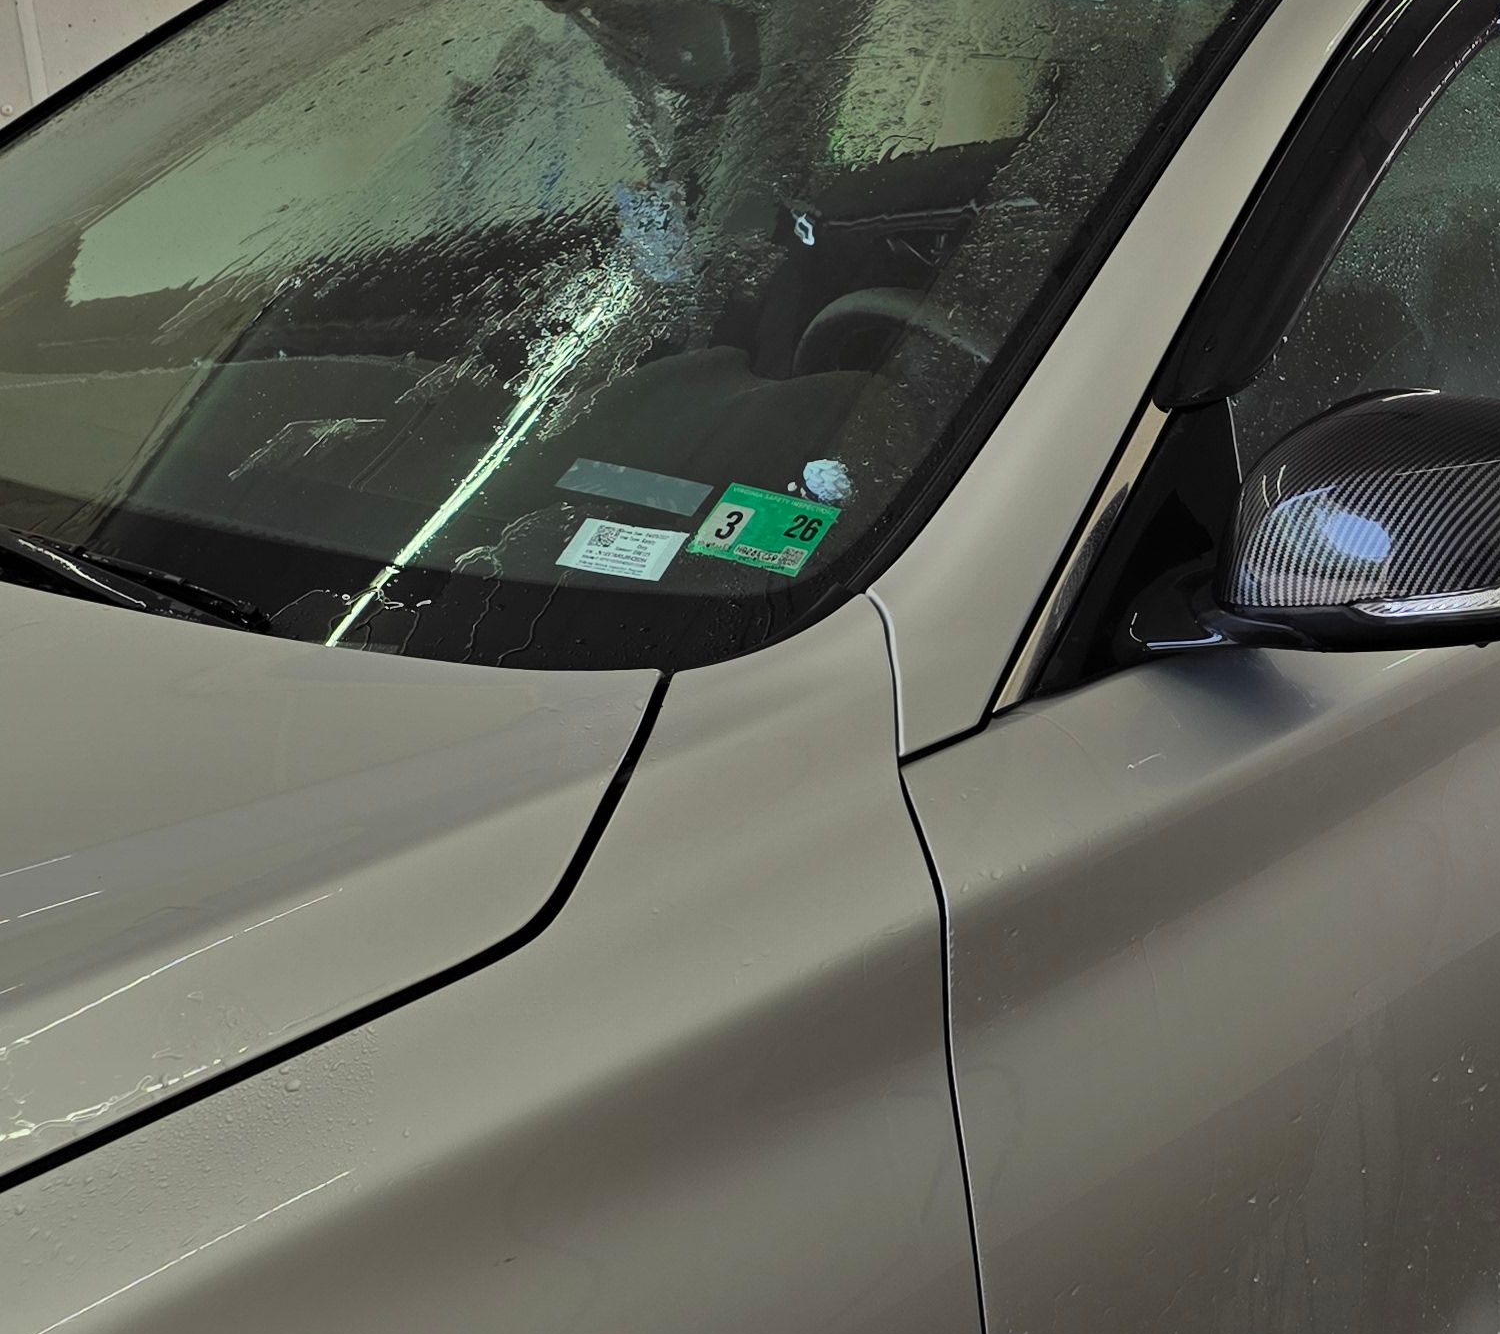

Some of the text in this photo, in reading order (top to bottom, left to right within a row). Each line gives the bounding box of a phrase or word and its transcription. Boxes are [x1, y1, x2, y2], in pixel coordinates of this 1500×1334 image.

[733, 486, 836, 515] VIRGINIA SAFETY INSPECTION
[715, 510, 823, 543] 3 26
